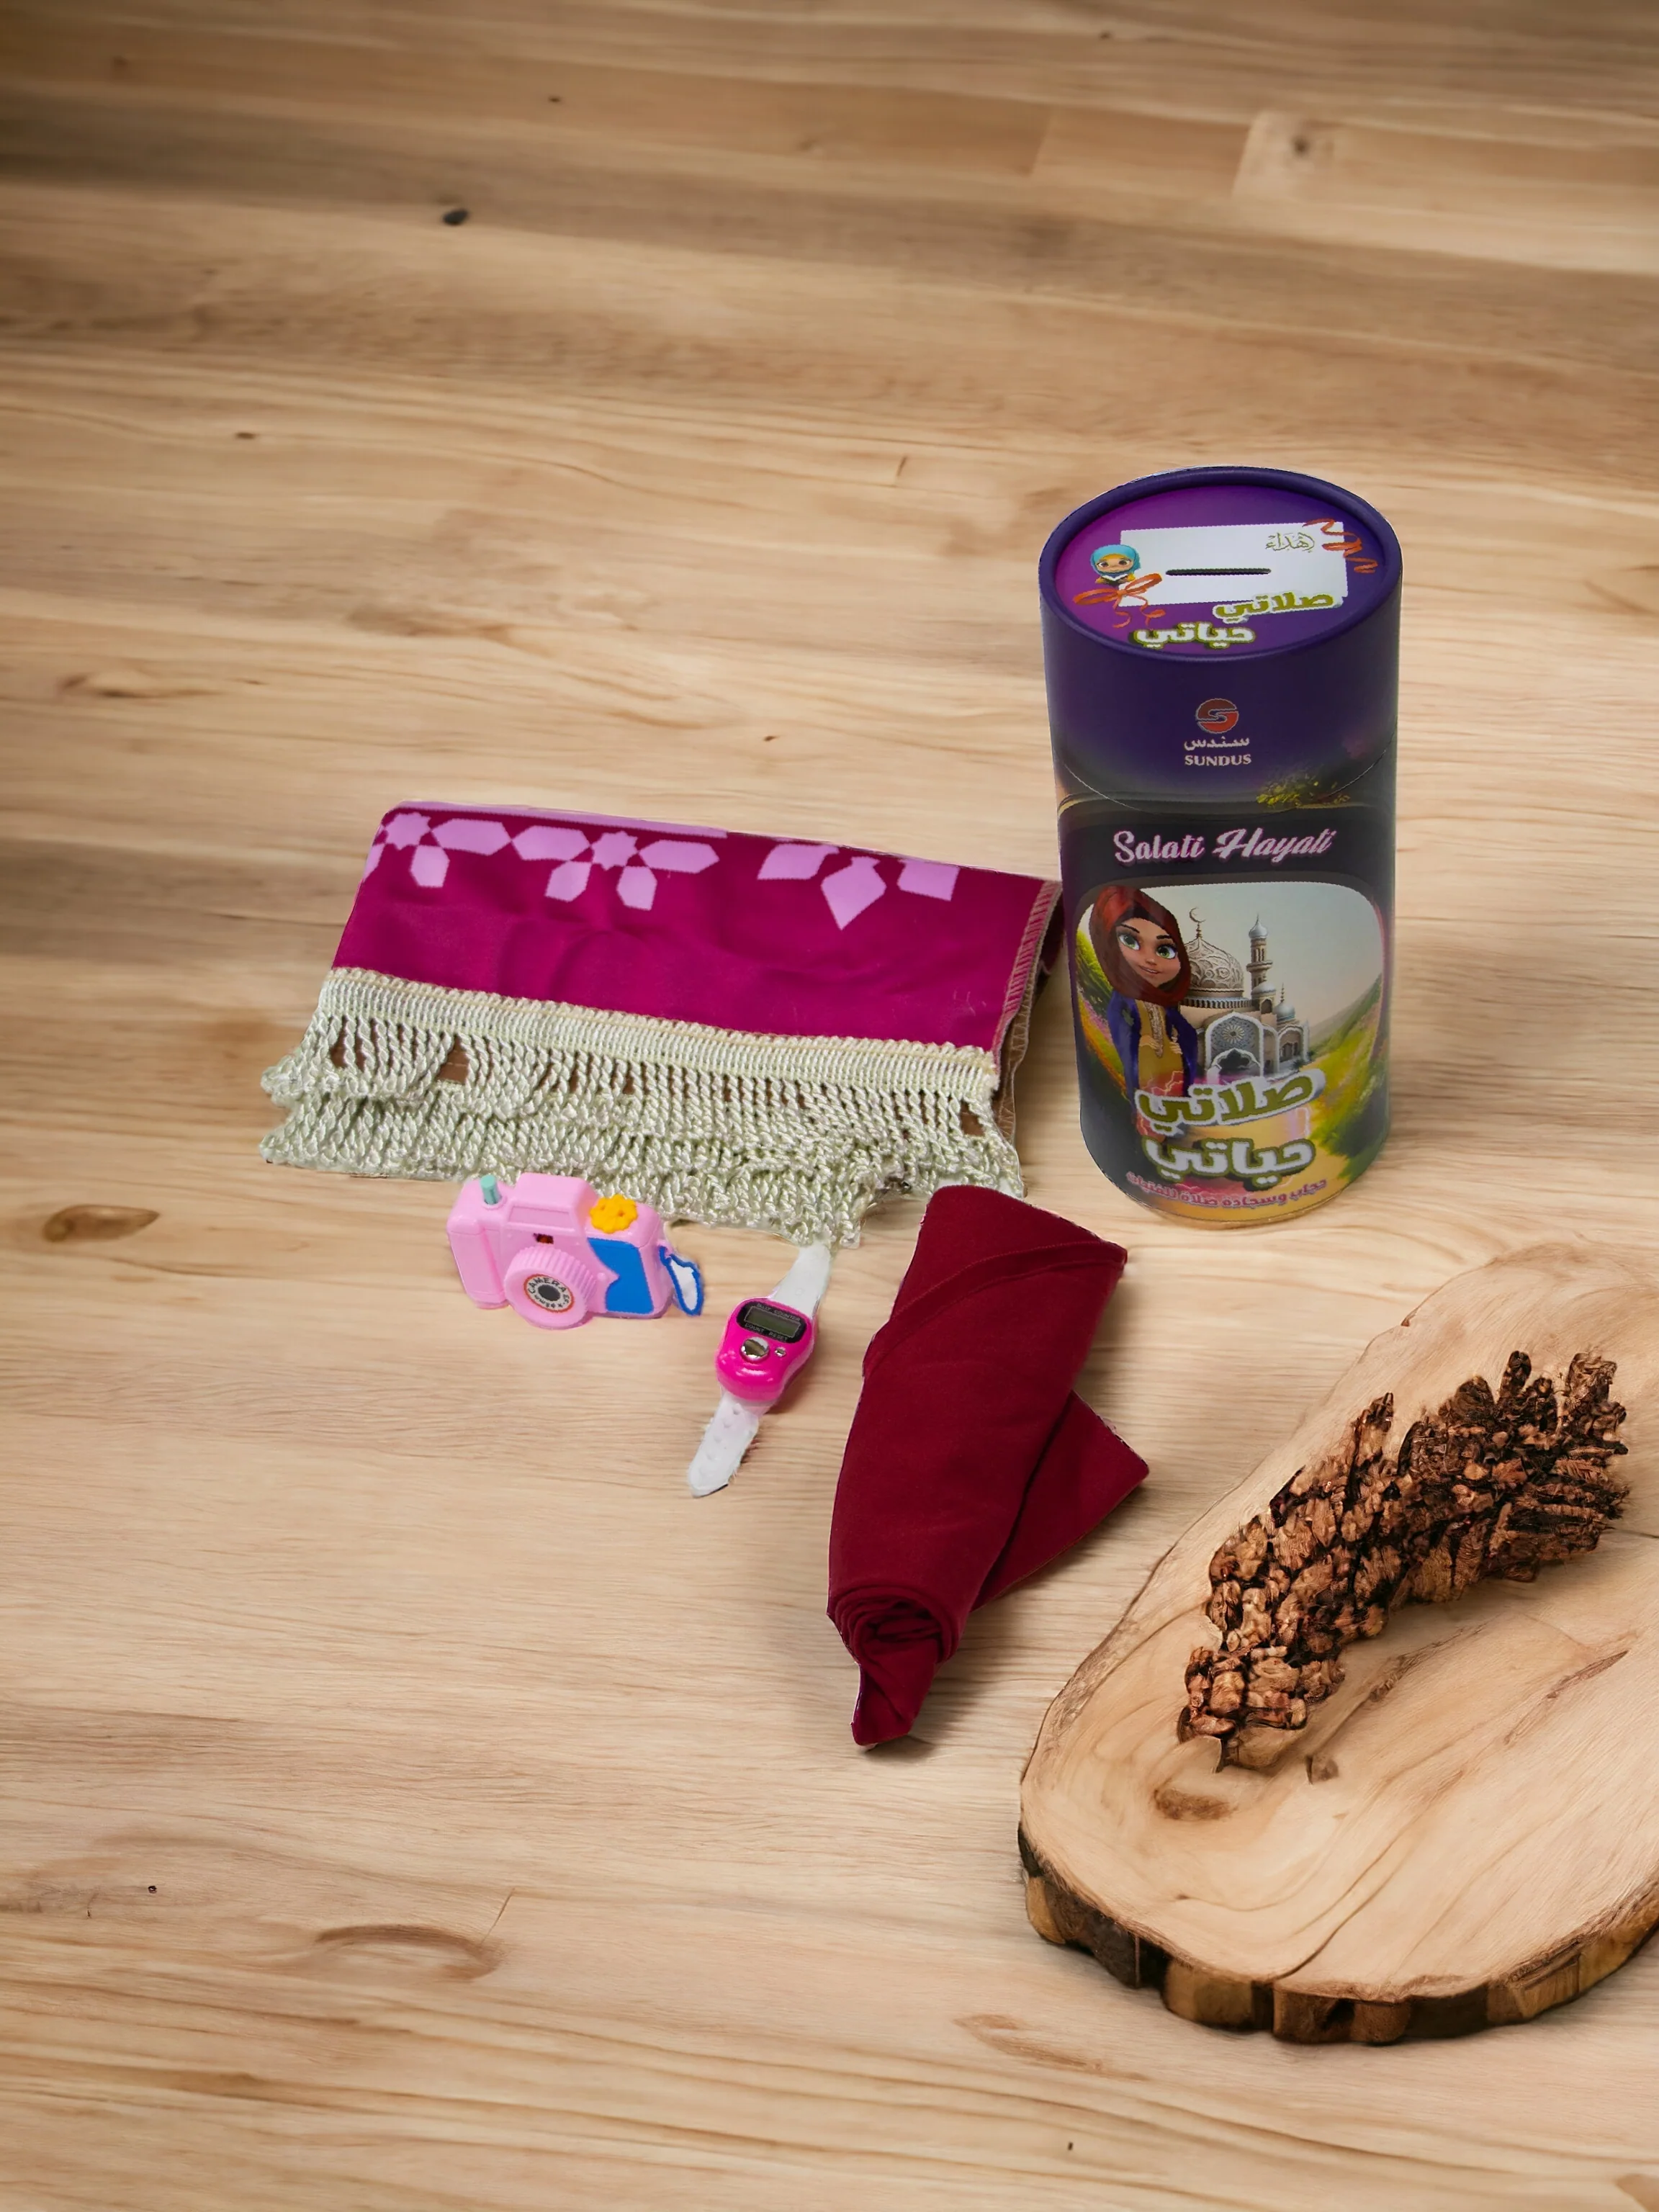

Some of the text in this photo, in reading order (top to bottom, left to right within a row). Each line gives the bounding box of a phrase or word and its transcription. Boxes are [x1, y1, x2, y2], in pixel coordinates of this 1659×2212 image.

[1213, 591, 1335, 623] صلاتي
[1133, 621, 1256, 648] حياتي
[1184, 736, 1250, 751] سندس
[1184, 754, 1252, 767] SUNDUS
[1113, 827, 1337, 863] Salati Hayati
[1136, 1071, 1323, 1135] صلاتي
[1142, 1137, 1316, 1189] حياتي
[1181, 1190, 1218, 1208] صلاة
[528, 1277, 567, 1294] CAMERA
